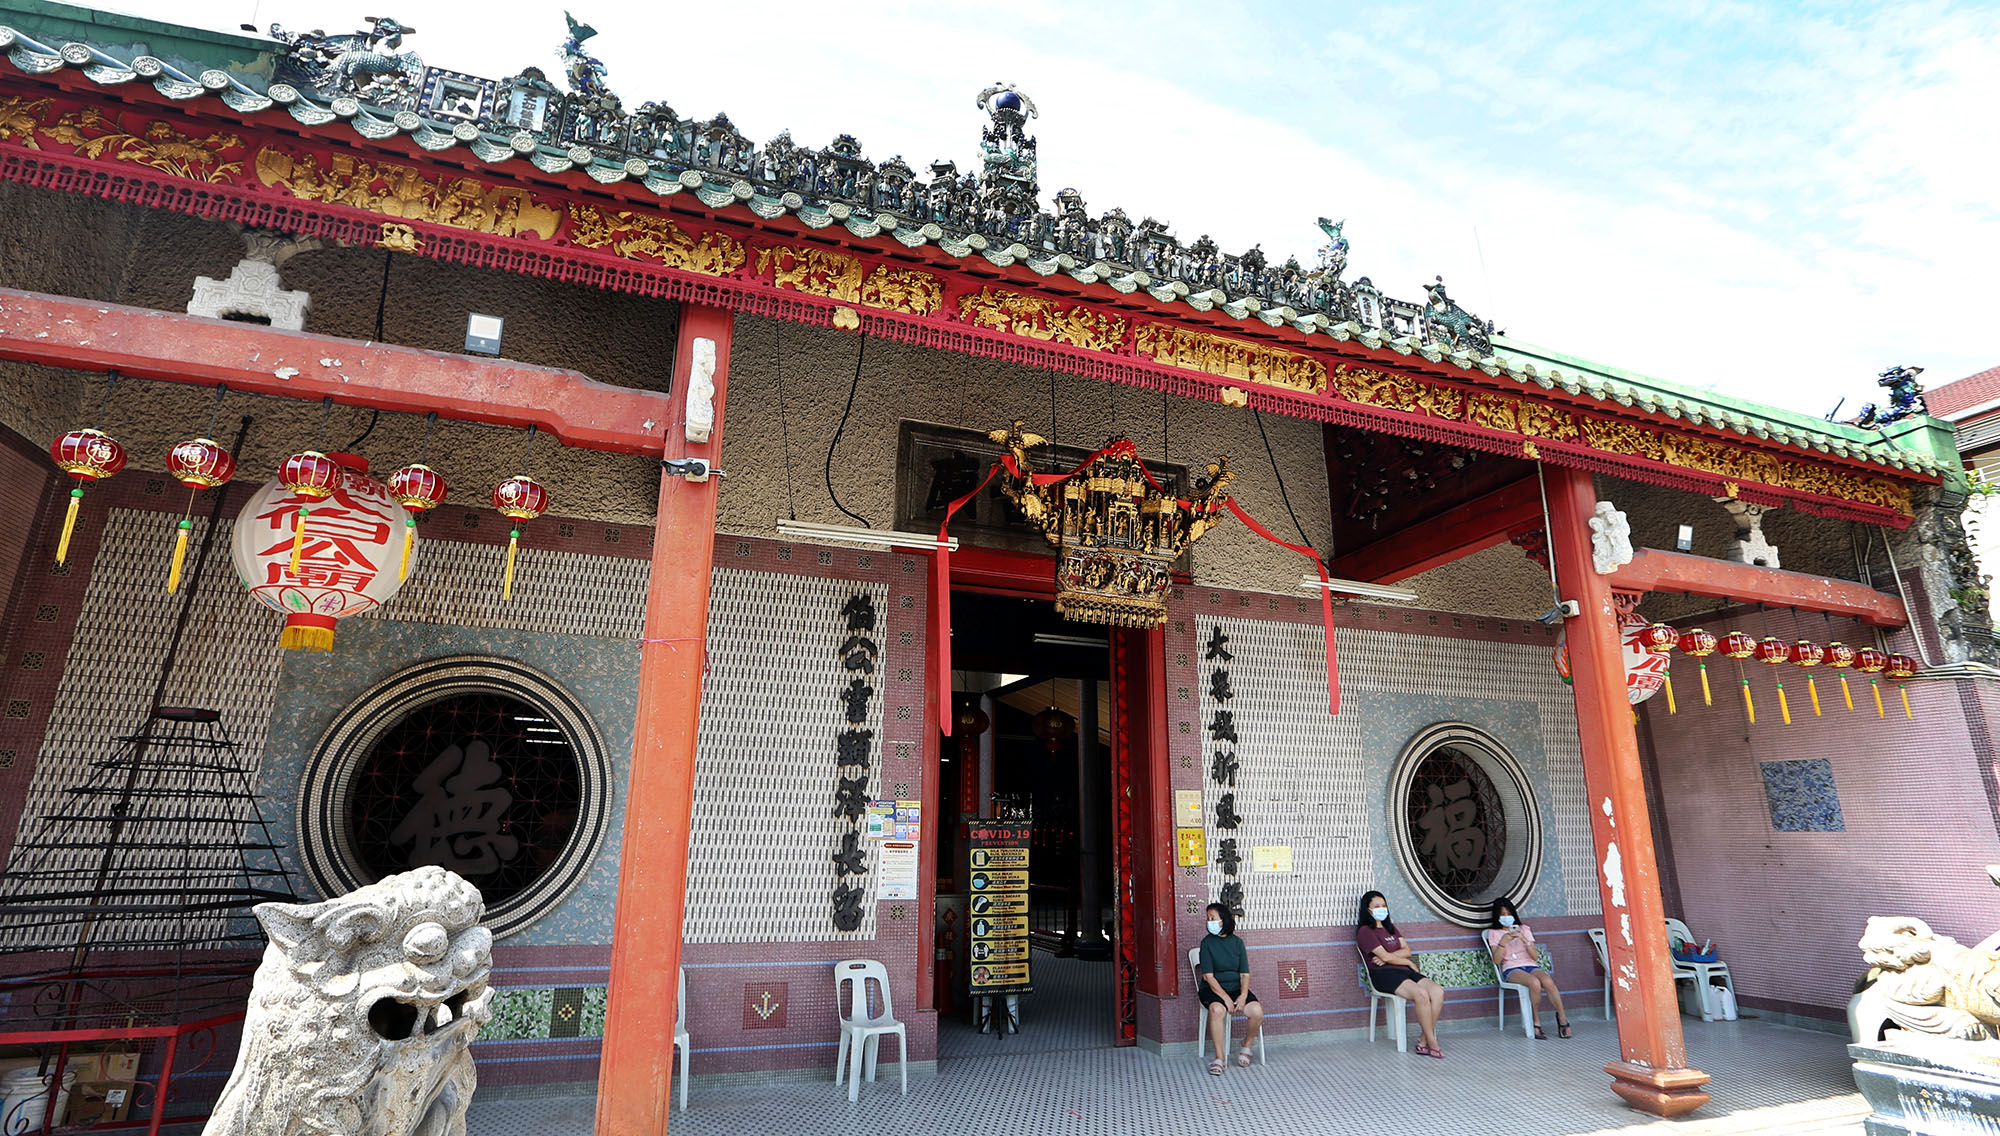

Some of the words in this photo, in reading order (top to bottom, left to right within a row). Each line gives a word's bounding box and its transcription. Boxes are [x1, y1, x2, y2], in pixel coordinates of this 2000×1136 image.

[90, 441, 112, 459] 福
[181, 446, 202, 464] 福
[1416, 778, 1487, 877] 福
